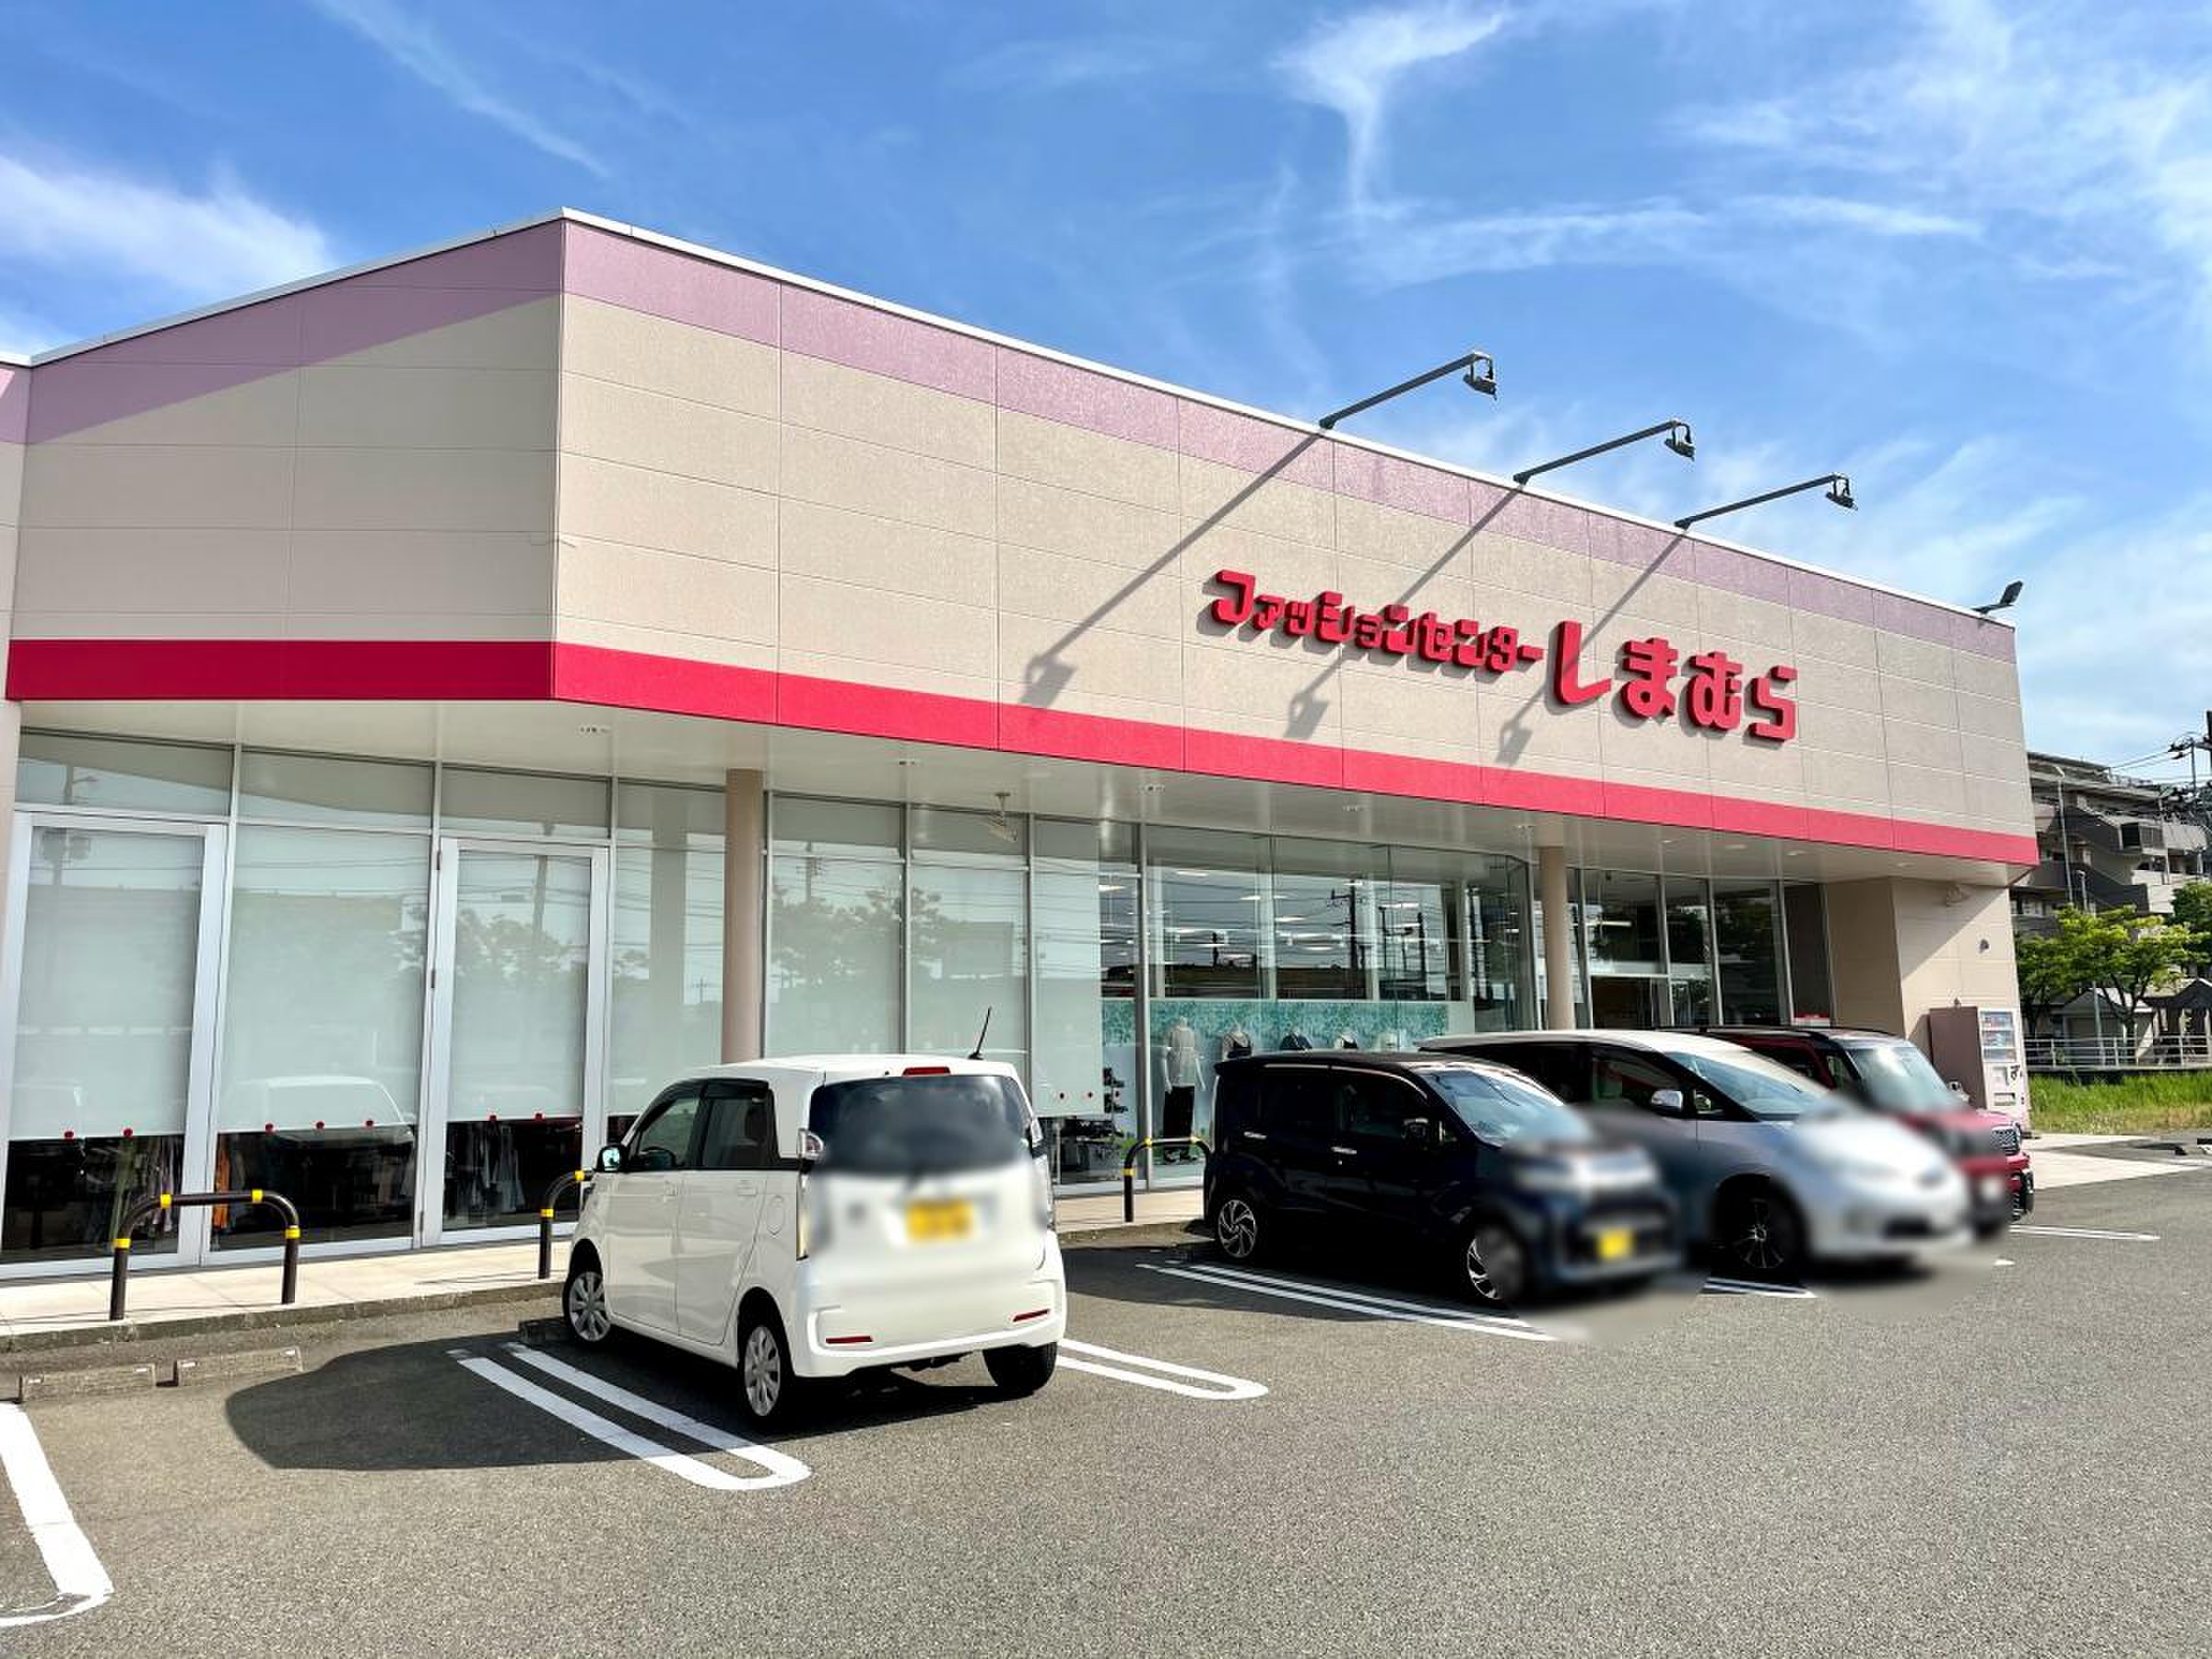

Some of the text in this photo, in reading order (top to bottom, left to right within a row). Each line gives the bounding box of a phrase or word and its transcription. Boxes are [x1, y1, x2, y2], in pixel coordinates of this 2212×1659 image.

[1210, 569, 1798, 742] ファッションセンター しまむら
